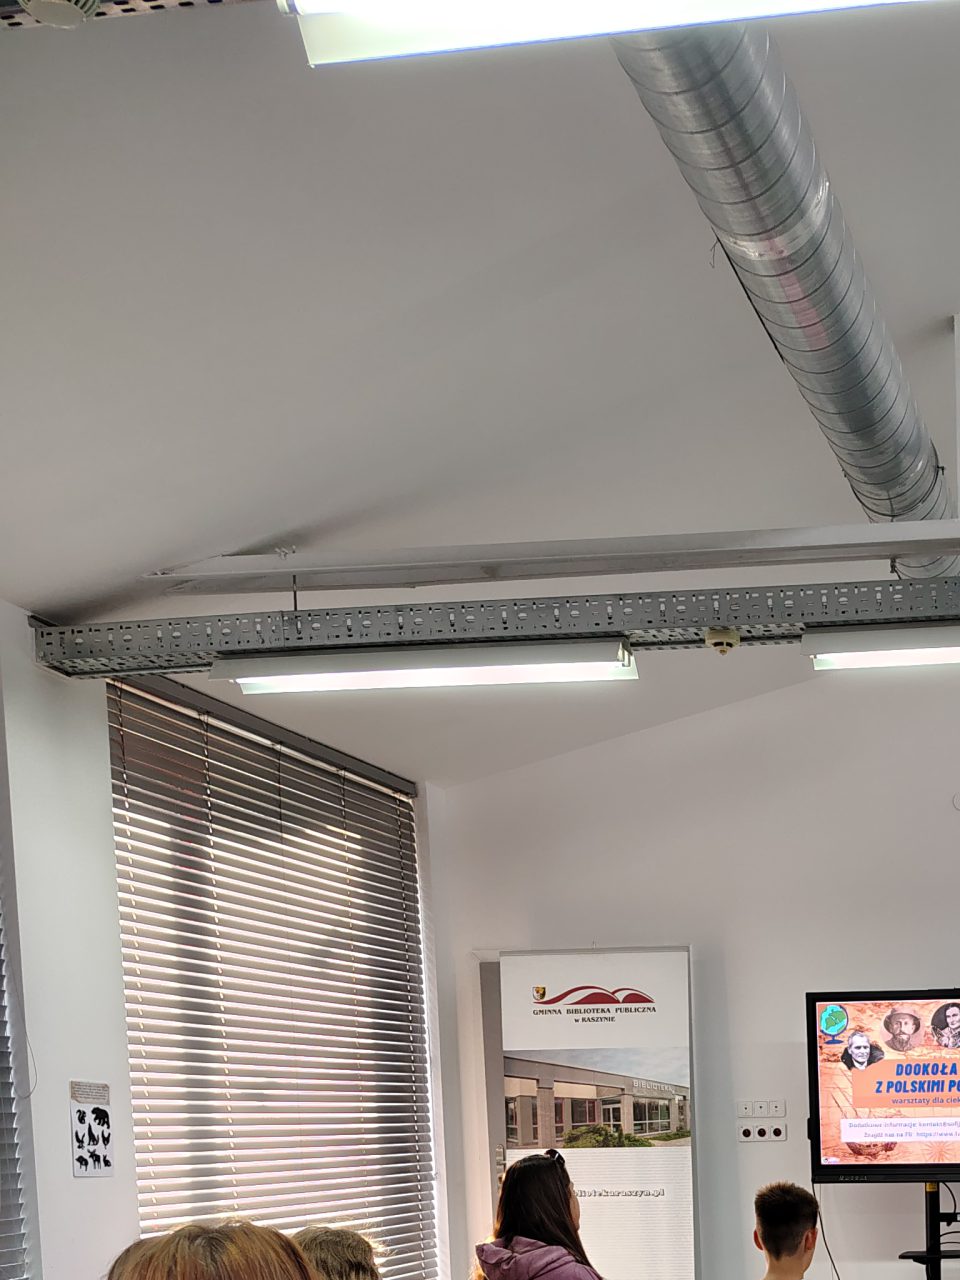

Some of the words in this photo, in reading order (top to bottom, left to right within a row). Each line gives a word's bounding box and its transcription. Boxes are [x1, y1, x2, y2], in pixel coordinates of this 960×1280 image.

[896, 1062, 958, 1076] DOOKOŁA
[875, 1081, 883, 1093] Z
[886, 1079, 945, 1093] POLSKIMI
[891, 1098, 930, 1106] warsztaty
[932, 1096, 944, 1104] dla
